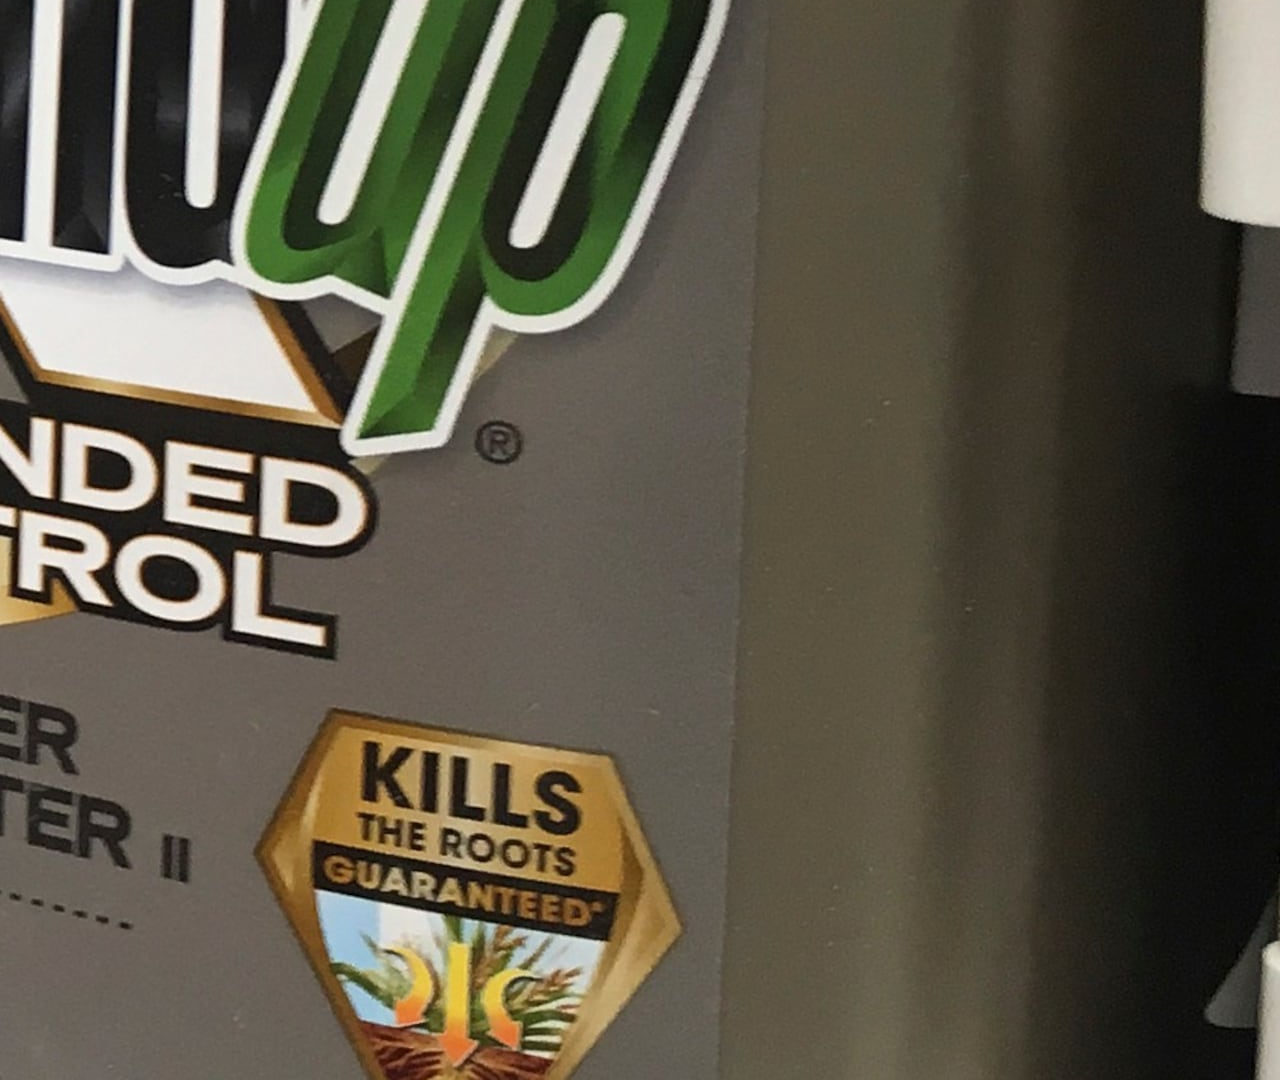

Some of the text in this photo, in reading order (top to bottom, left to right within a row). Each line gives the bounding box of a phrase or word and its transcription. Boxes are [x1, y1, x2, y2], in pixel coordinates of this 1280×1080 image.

[360, 740, 583, 837] KILLS
[160, 833, 192, 884] II
[356, 810, 578, 878] THE ROOTS
